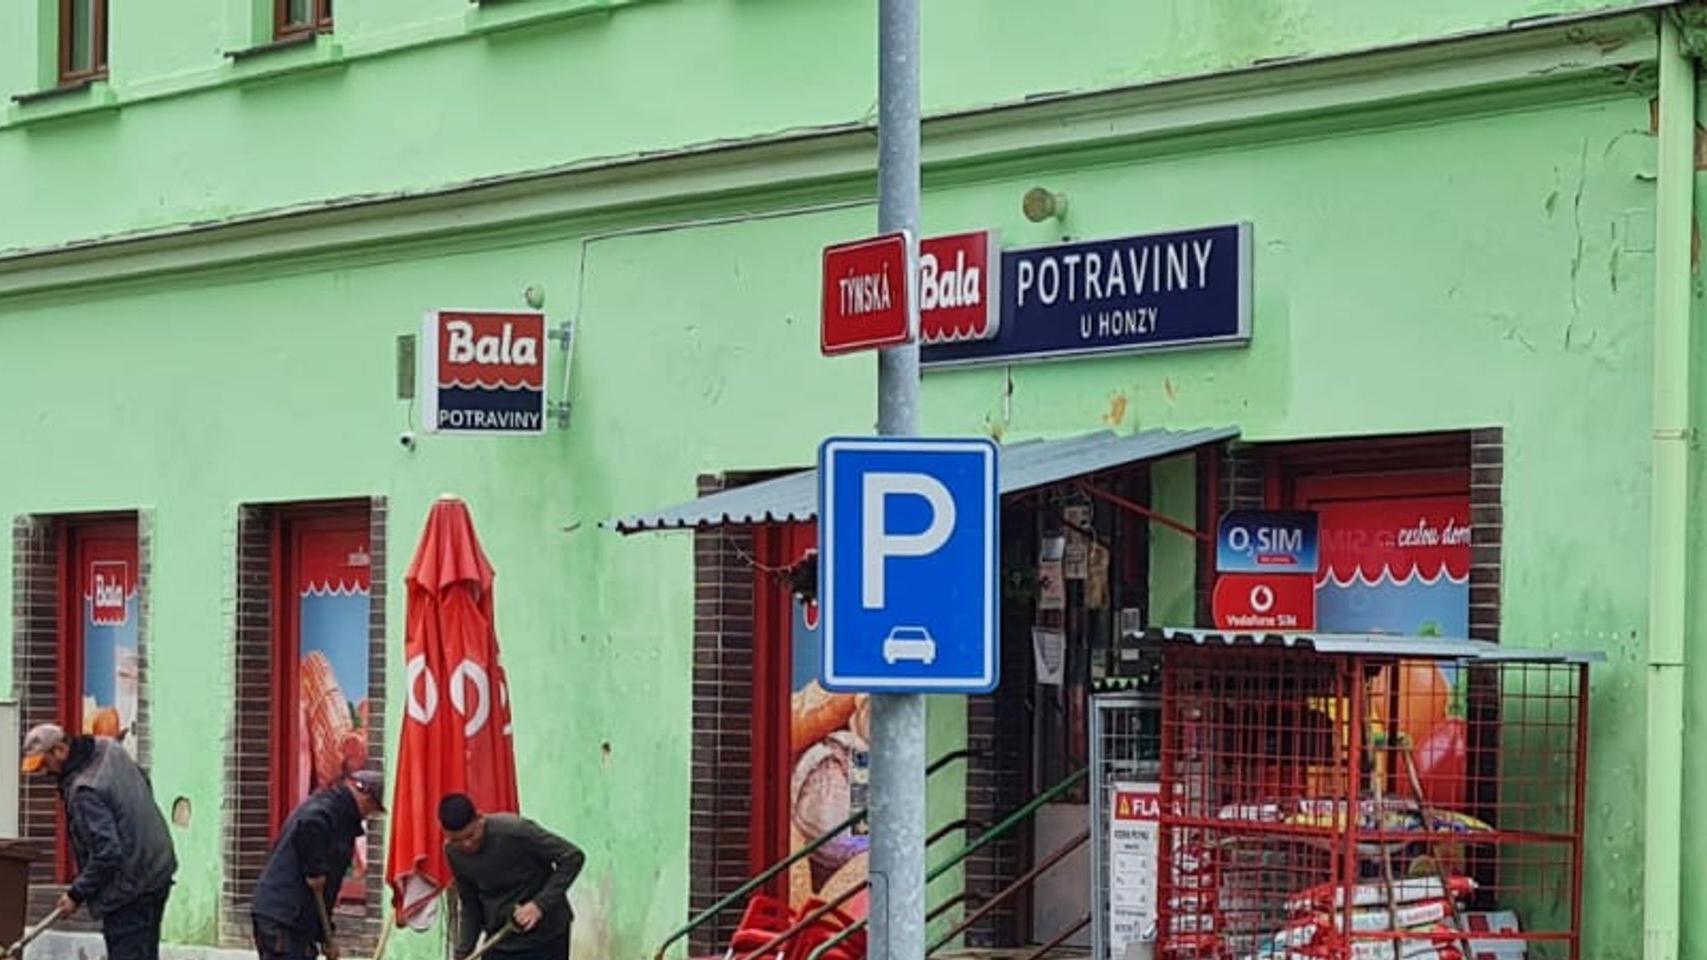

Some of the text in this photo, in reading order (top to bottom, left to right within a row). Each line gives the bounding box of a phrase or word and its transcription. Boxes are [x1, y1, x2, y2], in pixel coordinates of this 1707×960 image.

[839, 261, 891, 316] TÝNSKÁ
[920, 250, 980, 310] Bala
[1018, 239, 1212, 307] POTRAVINY
[1080, 307, 1158, 339] U HONZY
[446, 320, 537, 365] Bala
[439, 409, 540, 428] POTRAVINY
[862, 472, 956, 609] P
[1257, 527, 1302, 551] SIM
[96, 574, 123, 607] Bala
[1226, 614, 1275, 627] Vodafone
[1132, 799, 1182, 816] FLAA
